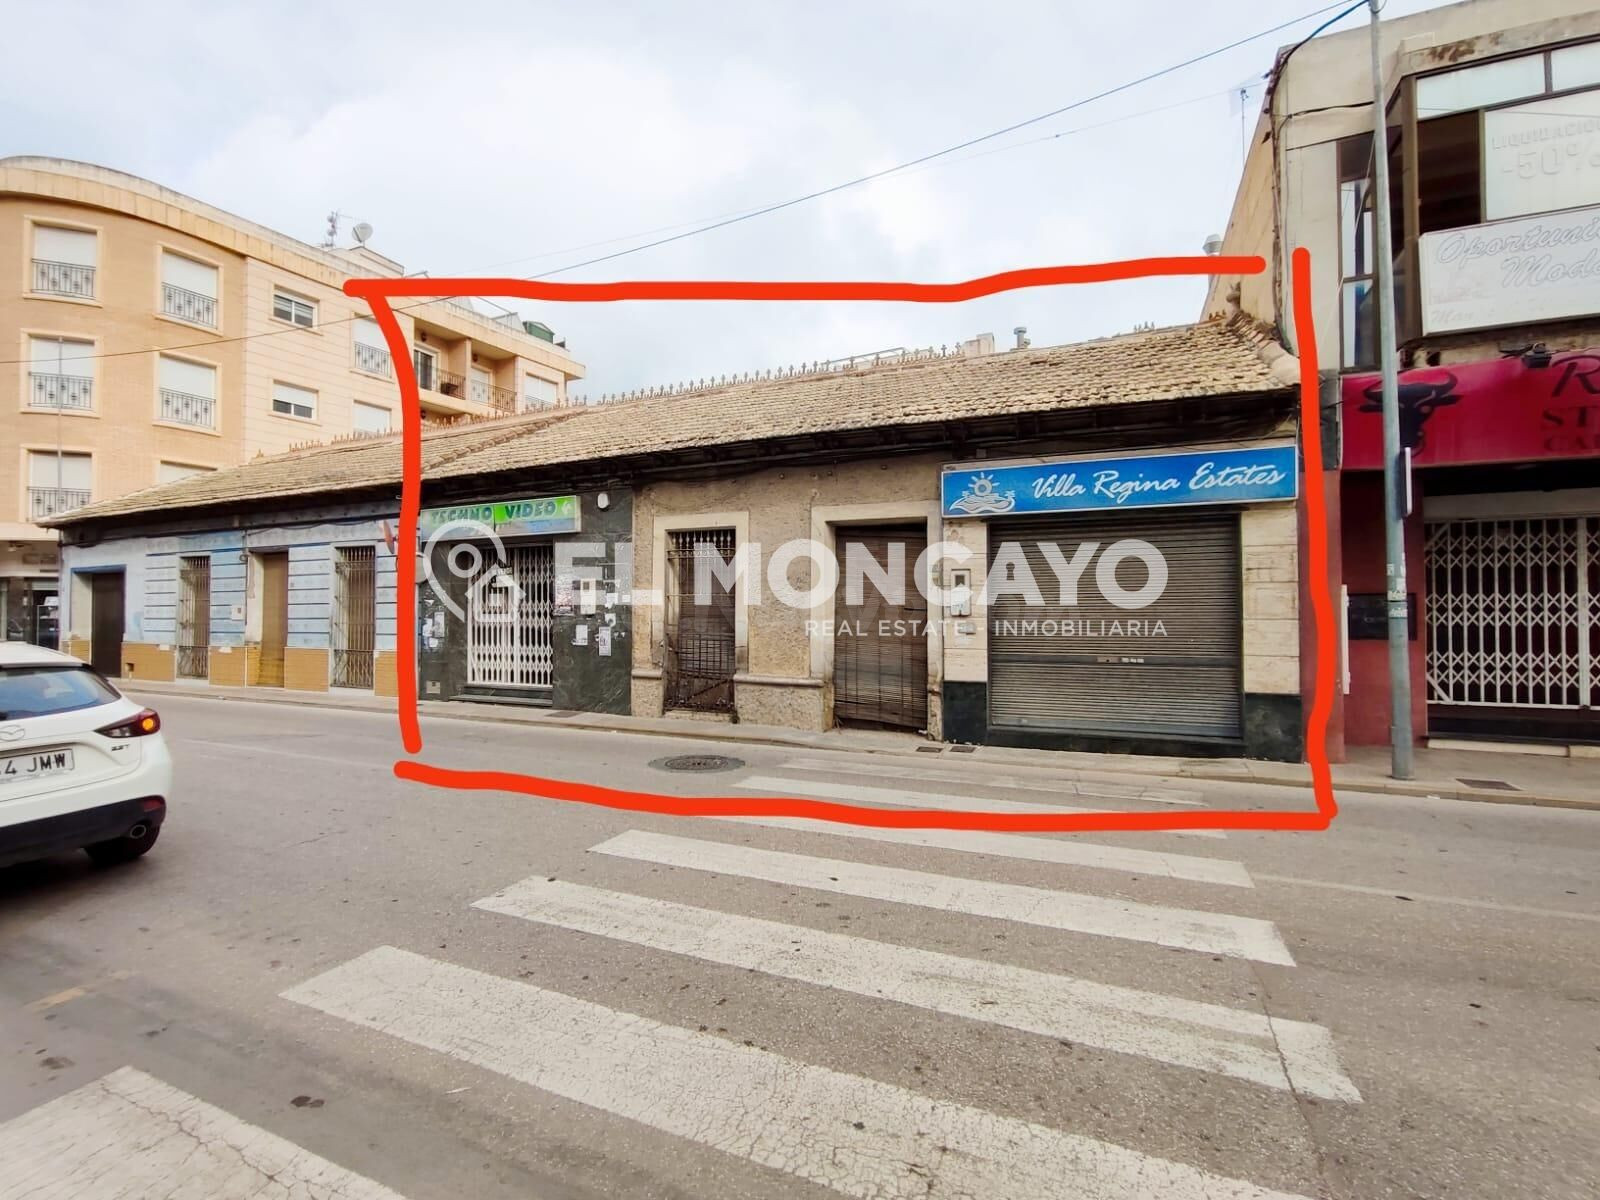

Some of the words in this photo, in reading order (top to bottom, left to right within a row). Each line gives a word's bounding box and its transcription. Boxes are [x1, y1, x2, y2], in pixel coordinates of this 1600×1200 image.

[1437, 216, 1600, 270] Oportuni
[1031, 473, 1086, 500] Villa
[1093, 469, 1180, 505] Regina
[1189, 461, 1287, 490] Estates
[504, 502, 557, 520] VIDEO
[27, 752, 66, 773] JMW
